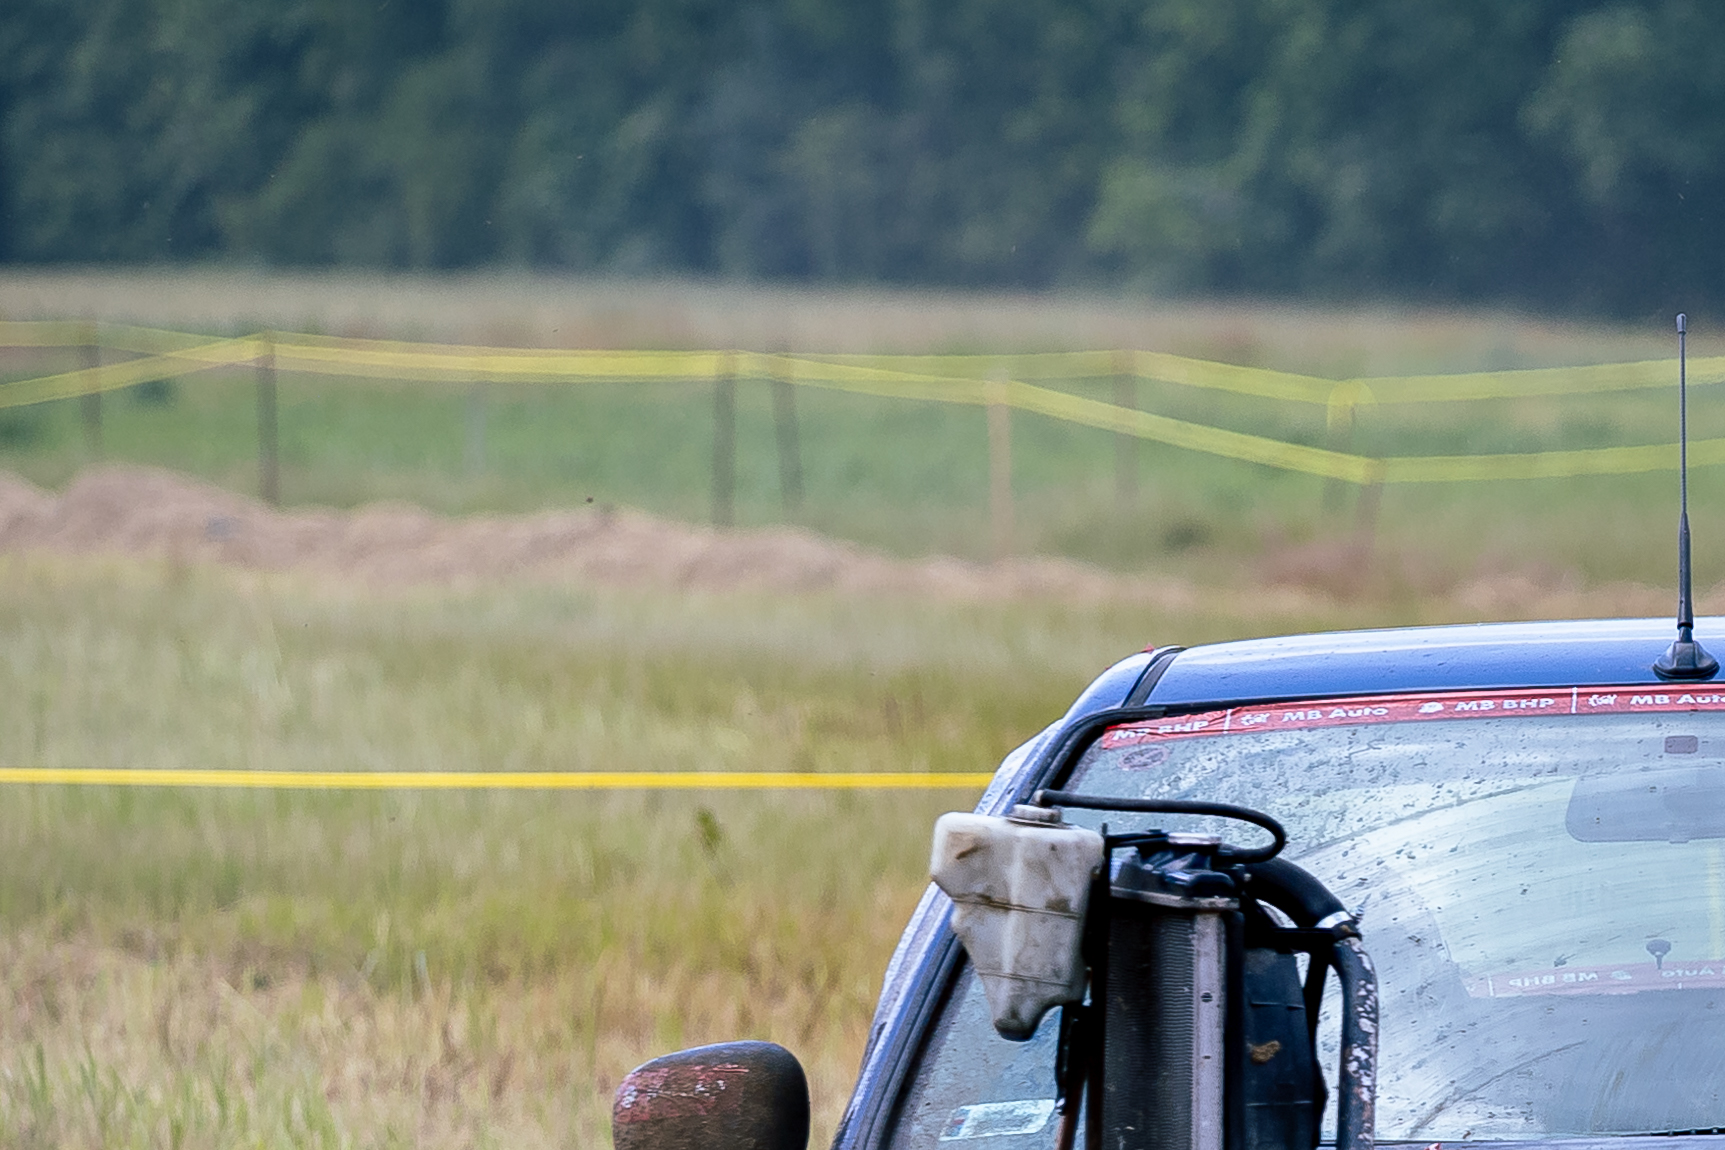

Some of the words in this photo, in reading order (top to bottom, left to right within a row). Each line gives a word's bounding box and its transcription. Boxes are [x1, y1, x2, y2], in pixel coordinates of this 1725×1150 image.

[1157, 720, 1209, 733] BHP
[1282, 710, 1321, 722] MB
[1328, 705, 1388, 719] Auto
[1455, 700, 1495, 712] MB
[1502, 697, 1554, 710] BHP
[1630, 693, 1670, 706] MB
